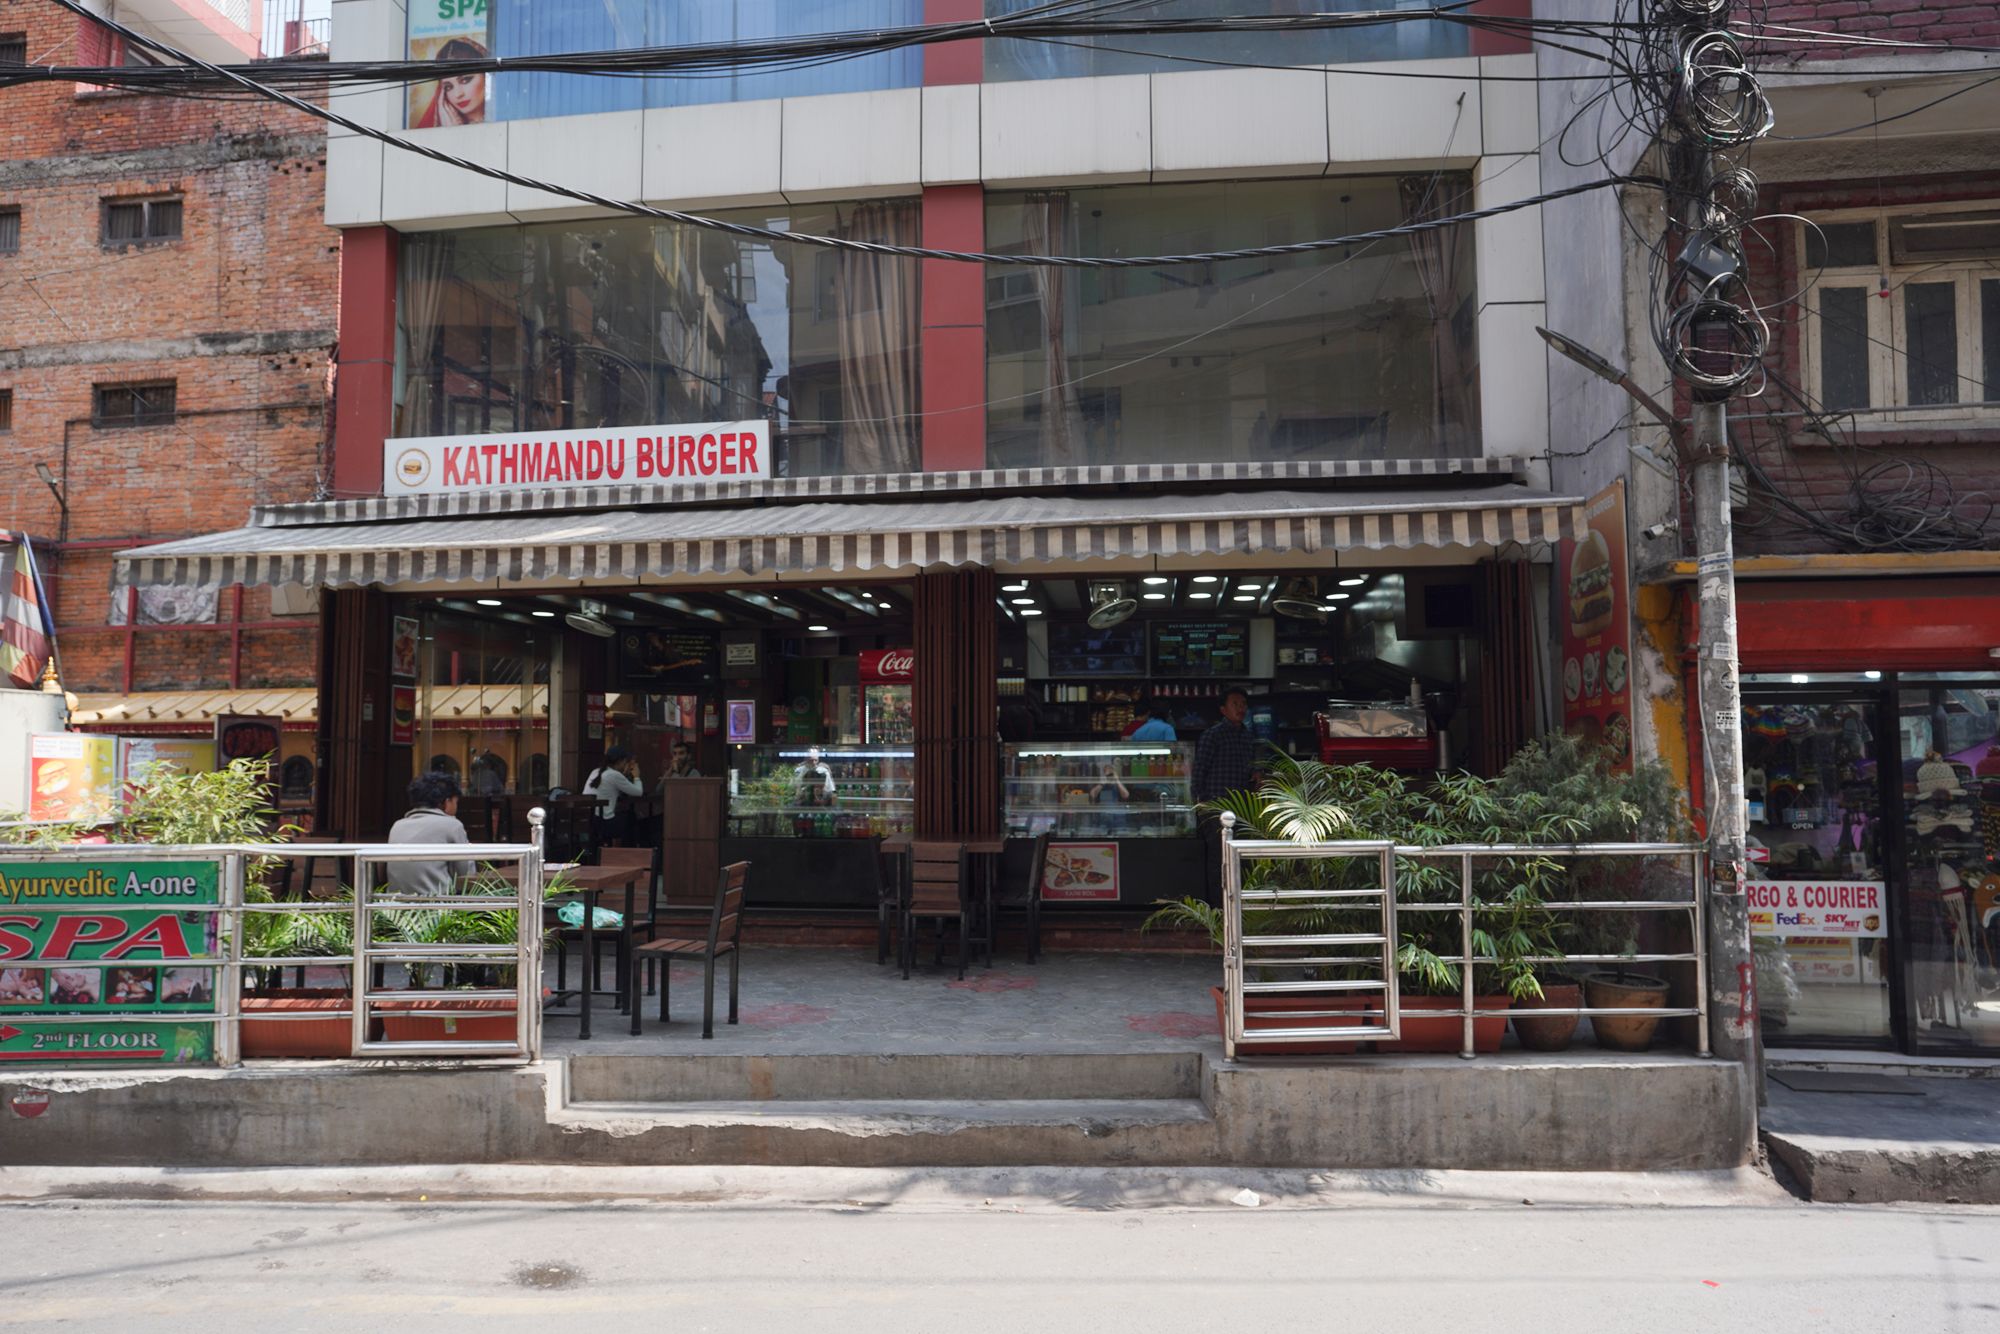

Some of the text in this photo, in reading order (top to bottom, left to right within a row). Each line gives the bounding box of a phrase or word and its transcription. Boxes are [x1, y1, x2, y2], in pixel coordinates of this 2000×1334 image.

[438, 0, 487, 19] SPA
[443, 431, 759, 486] KATHMANDU BURGER
[877, 651, 914, 676] Coca
[1791, 822, 1814, 830] OPEN
[0, 869, 197, 904] Ayurvedic A-one
[1747, 885, 1879, 909] RGO & COURIER
[1776, 912, 1815, 925] FedEx
[1824, 913, 1848, 923] SKY
[0, 914, 192, 960] SPA
[32, 1032, 159, 1048] 2nd FLOOR
